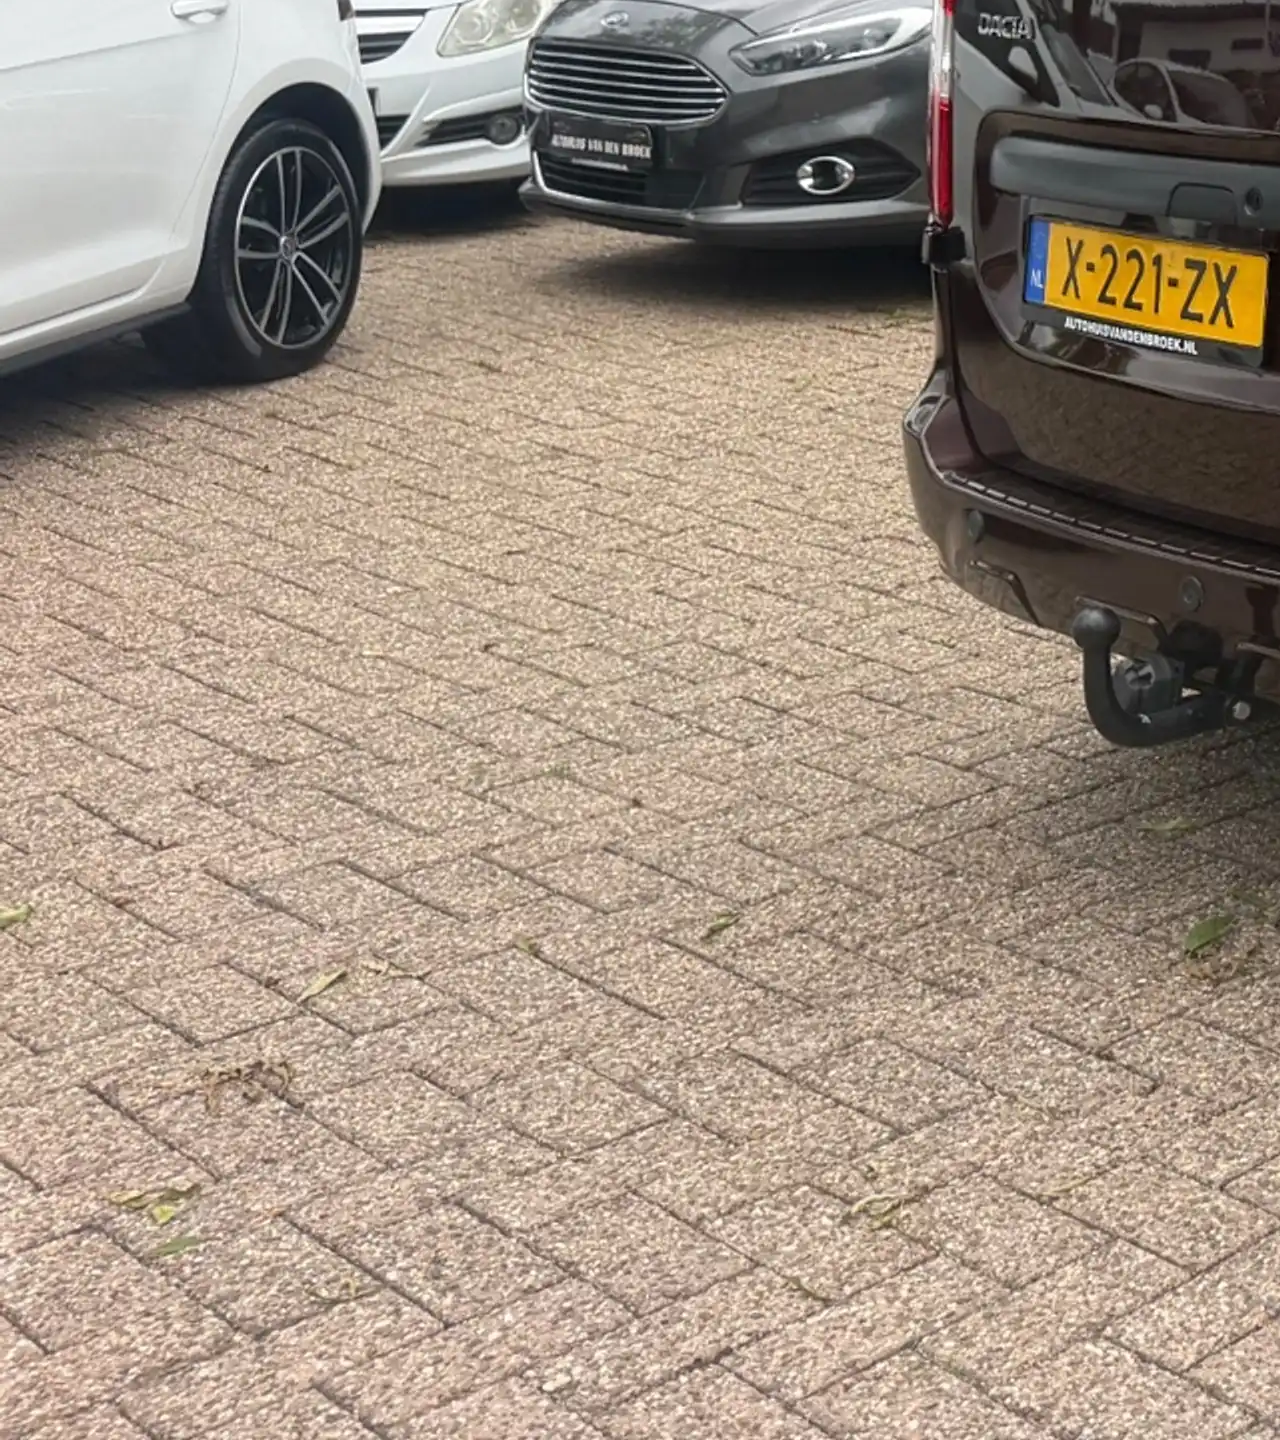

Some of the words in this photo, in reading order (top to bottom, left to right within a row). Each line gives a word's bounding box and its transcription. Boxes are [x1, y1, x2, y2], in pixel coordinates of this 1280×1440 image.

[978, 12, 1033, 40] DACIA
[1030, 270, 1044, 289] NL
[1061, 236, 1238, 328] X-221-ZX
[1063, 316, 1199, 356] AUTOHUISVANDENBROEK.NL
